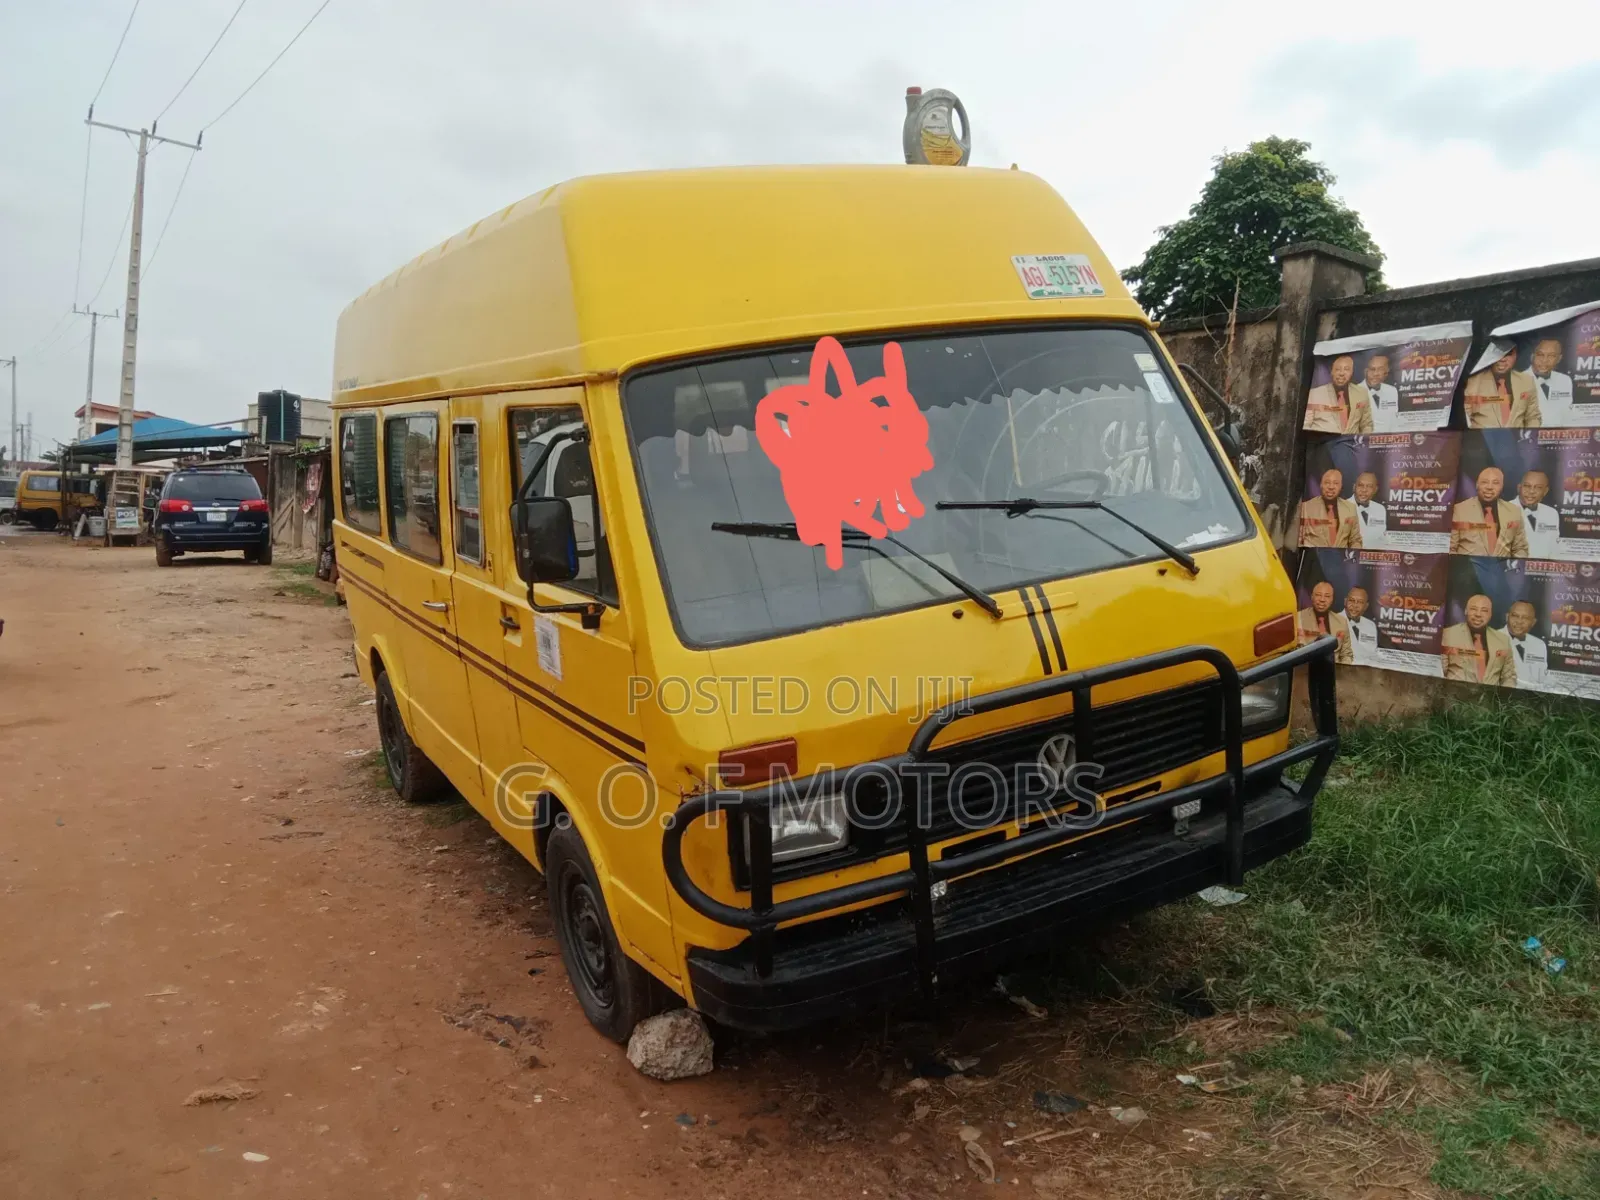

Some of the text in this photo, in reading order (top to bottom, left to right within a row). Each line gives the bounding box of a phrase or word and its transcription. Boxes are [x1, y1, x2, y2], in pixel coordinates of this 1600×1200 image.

[1022, 266, 1052, 287] AGL
[1401, 365, 1459, 382] MERCY
[1369, 434, 1411, 444] RHEMA
[1539, 429, 1590, 440] RHEMA
[1392, 461, 1441, 469] CONVENTION
[1389, 489, 1447, 502] MERCY
[1360, 552, 1401, 562] RHEMA
[1525, 561, 1577, 573] RHEMA
[1383, 580, 1432, 588] CONVENTION
[1380, 607, 1437, 624] MERCY
